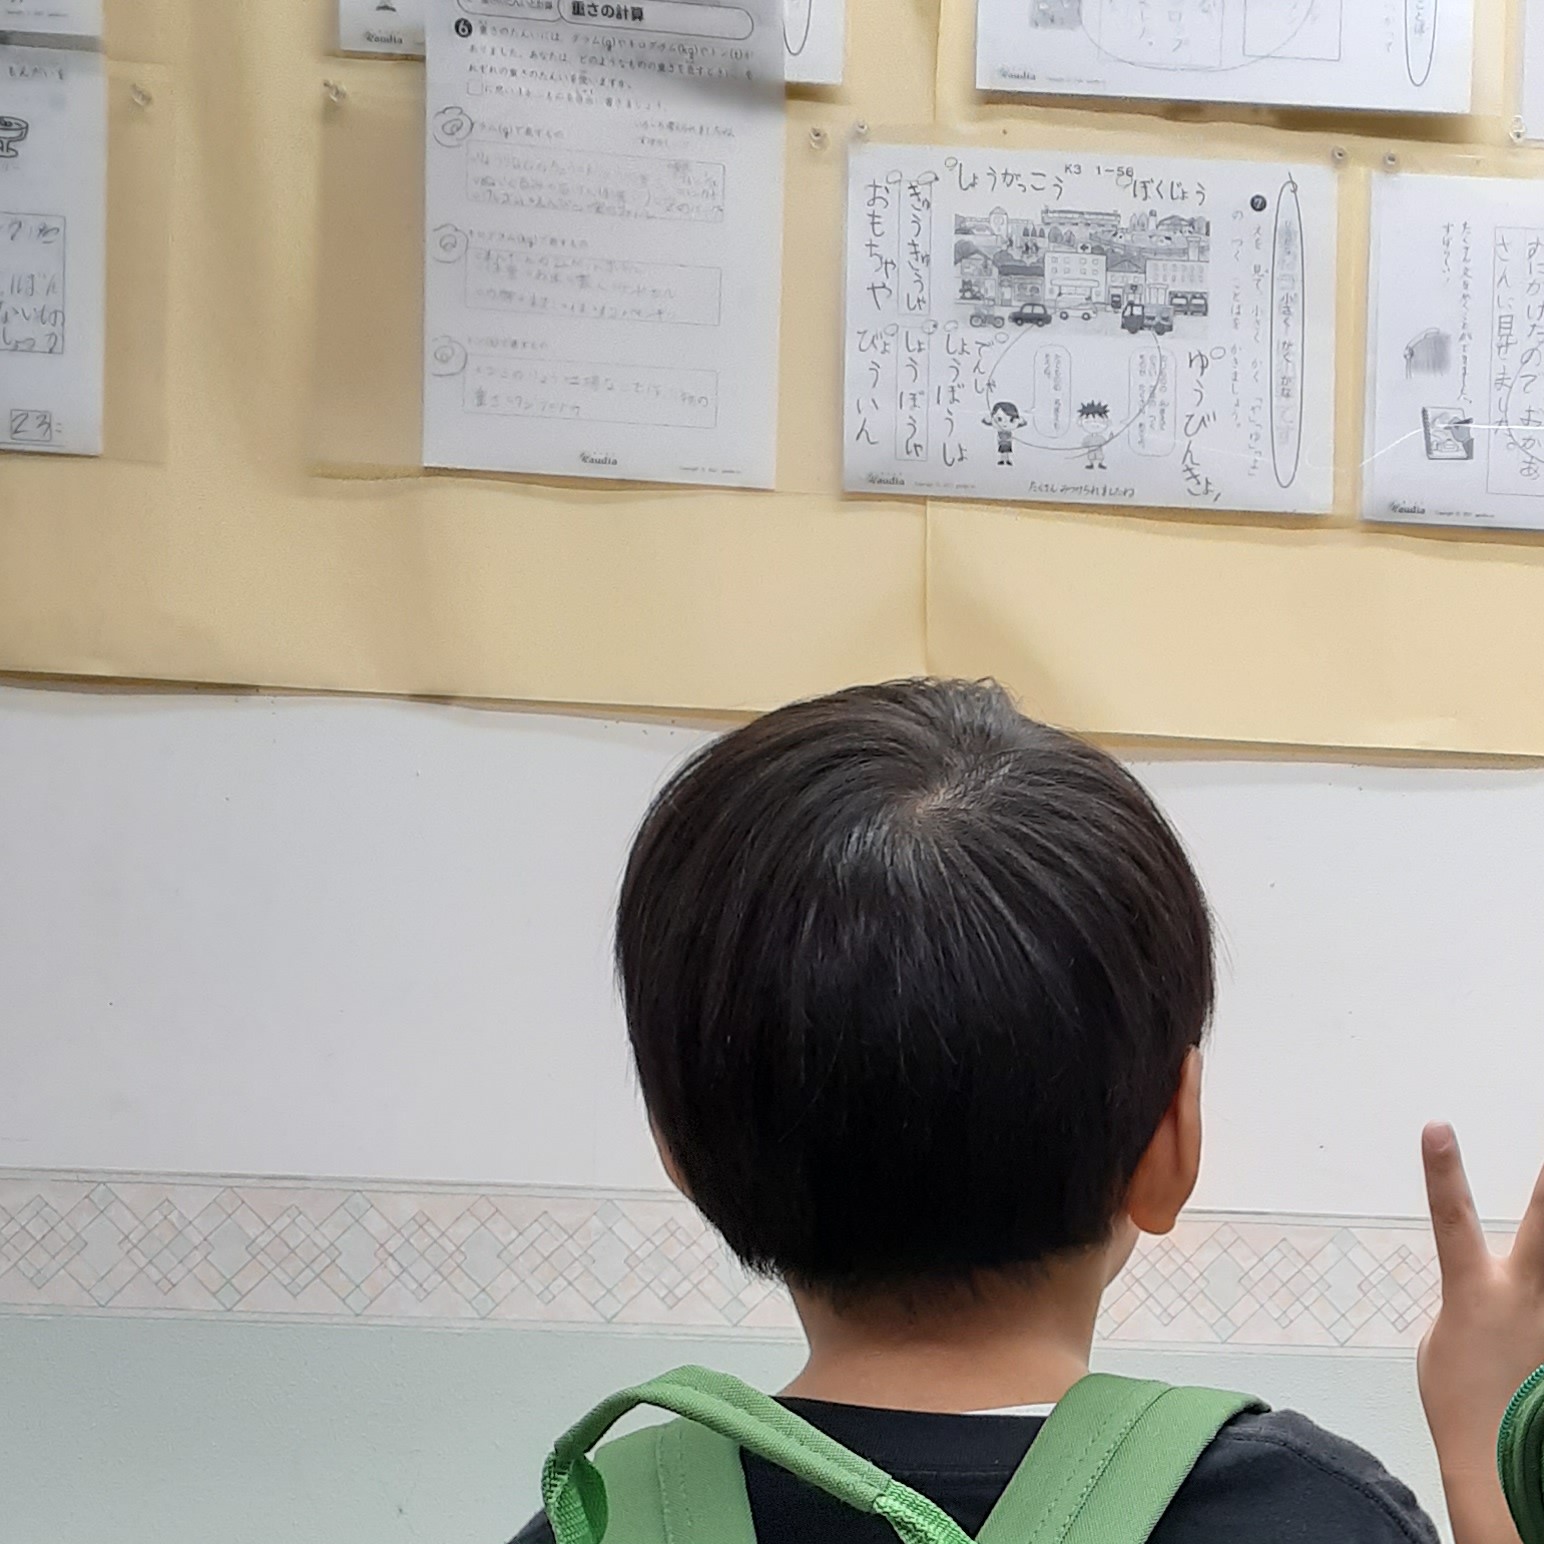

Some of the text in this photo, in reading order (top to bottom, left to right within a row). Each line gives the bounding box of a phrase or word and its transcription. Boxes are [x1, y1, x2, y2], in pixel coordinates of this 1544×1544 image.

[571, 0, 644, 22] 重さの計算
[959, 163, 1064, 201] しょうがっこう
[1064, 163, 1082, 174] K3
[1132, 178, 1206, 206] ぼくじょう
[865, 179, 896, 311] おもちゃや
[856, 330, 889, 445] びょういん
